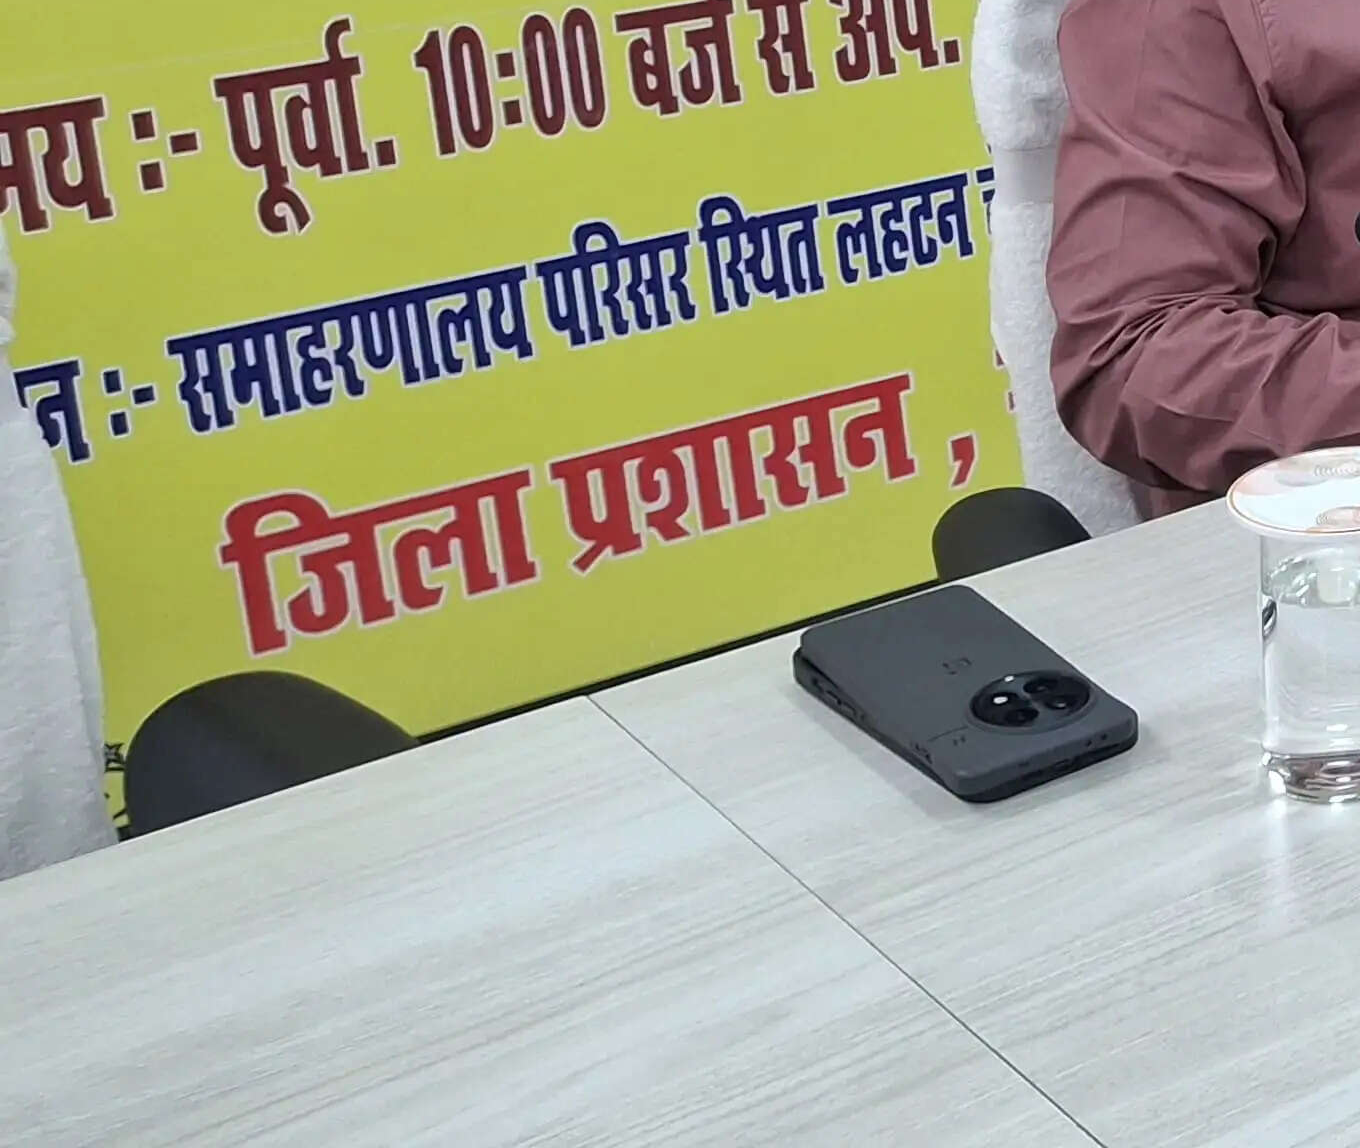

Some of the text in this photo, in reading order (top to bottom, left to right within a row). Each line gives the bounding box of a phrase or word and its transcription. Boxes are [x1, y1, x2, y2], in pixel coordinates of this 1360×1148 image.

[0, 96, 116, 234] मय
[413, 6, 603, 158] 10:00
[166, 262, 535, 435] समाहरणालय
[535, 218, 696, 349] परिसर
[698, 195, 825, 314] स्थित
[826, 171, 975, 286] लहटन
[219, 467, 539, 656] जिला
[549, 372, 917, 574] प्रशासन
